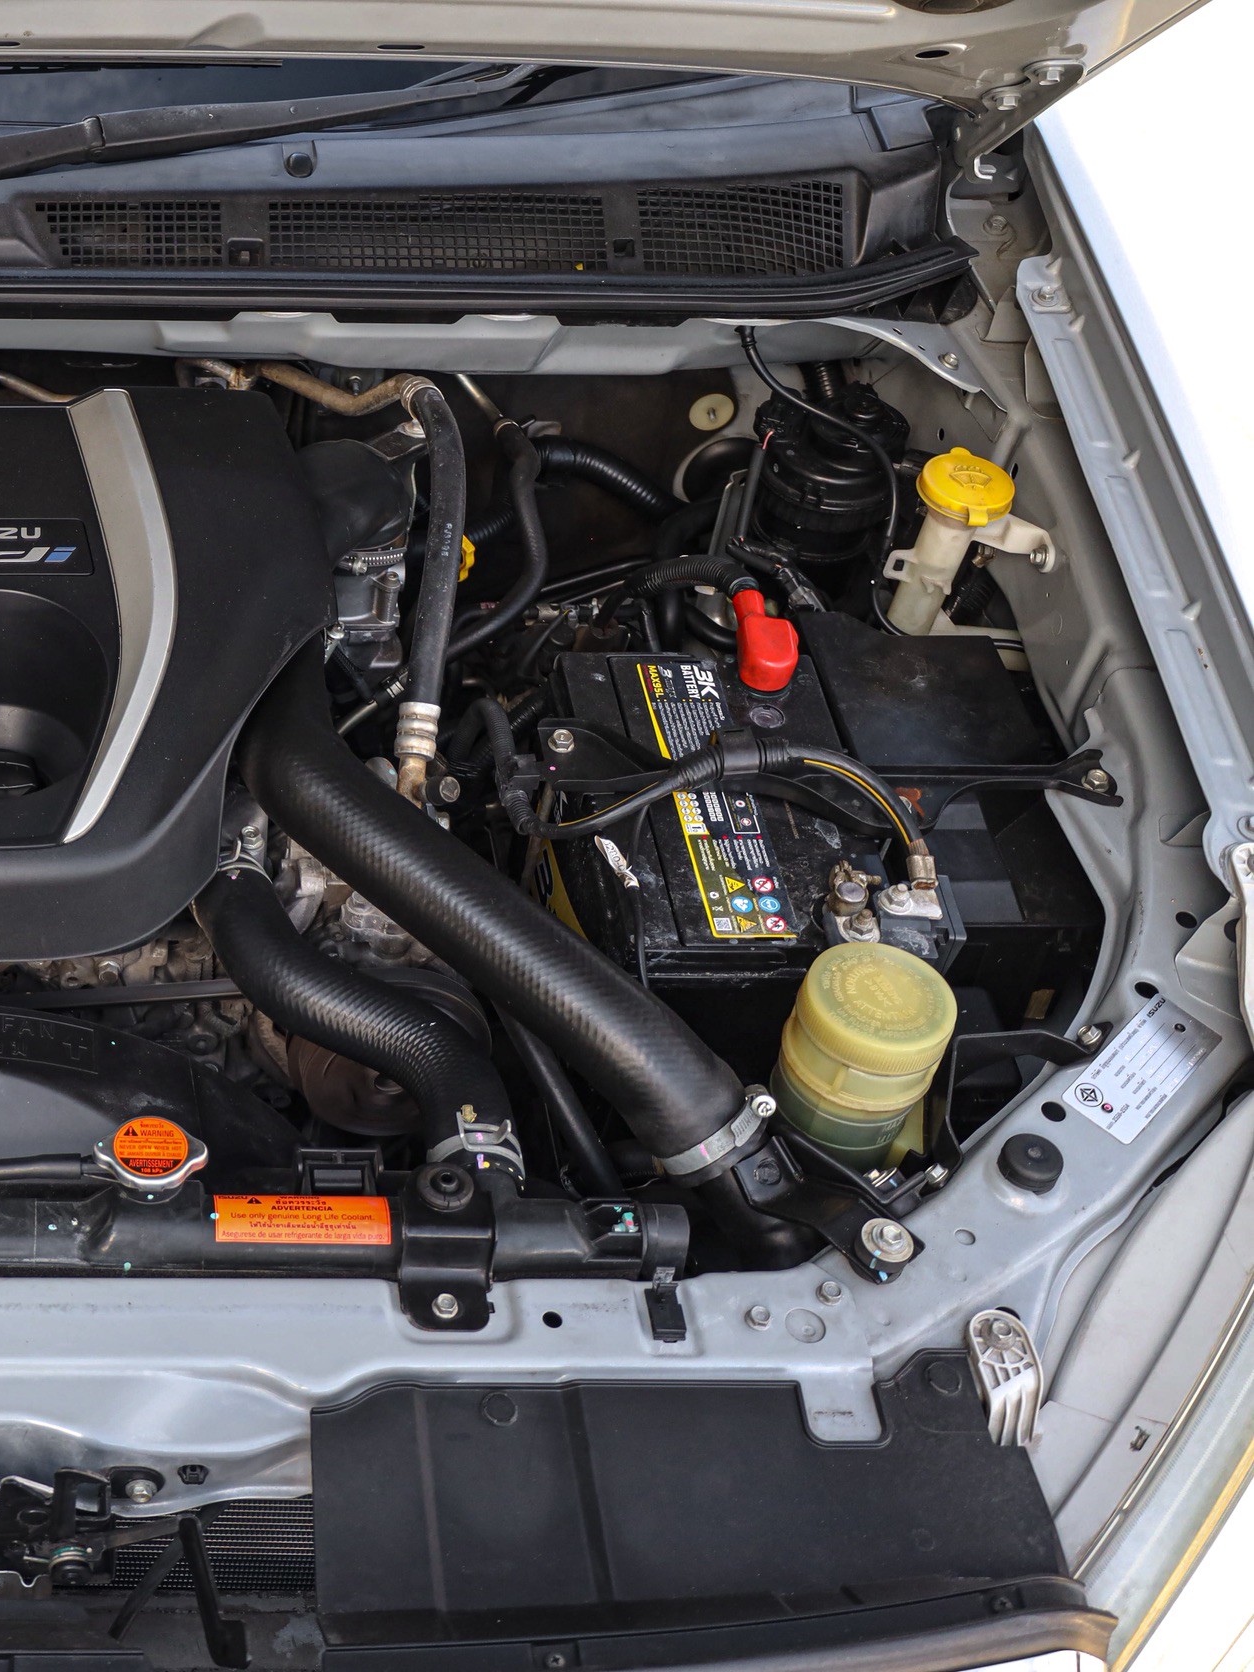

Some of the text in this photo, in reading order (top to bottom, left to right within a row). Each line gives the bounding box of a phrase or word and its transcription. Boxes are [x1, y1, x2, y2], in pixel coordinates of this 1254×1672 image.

[647, 664, 664, 699] MAX95L
[680, 664, 701, 700] BATTERY
[692, 665, 720, 700] 3K
[1147, 998, 1166, 1018] ISUZU
[140, 1129, 174, 1137] WARNING
[128, 1158, 174, 1167] AVERTISSEMENT
[249, 1212, 265, 1220] only
[267, 1213, 298, 1221] genuine
[302, 1213, 322, 1221] Long
[341, 1213, 376, 1221] Coolant.
[221, 1230, 258, 1239] Asegurese
[258, 1230, 267, 1238] de
[268, 1231, 283, 1239] usar
[284, 1230, 323, 1240] refrigerante
[324, 1231, 332, 1239] de
[334, 1231, 351, 1241] larga
[352, 1232, 367, 1240] vida
